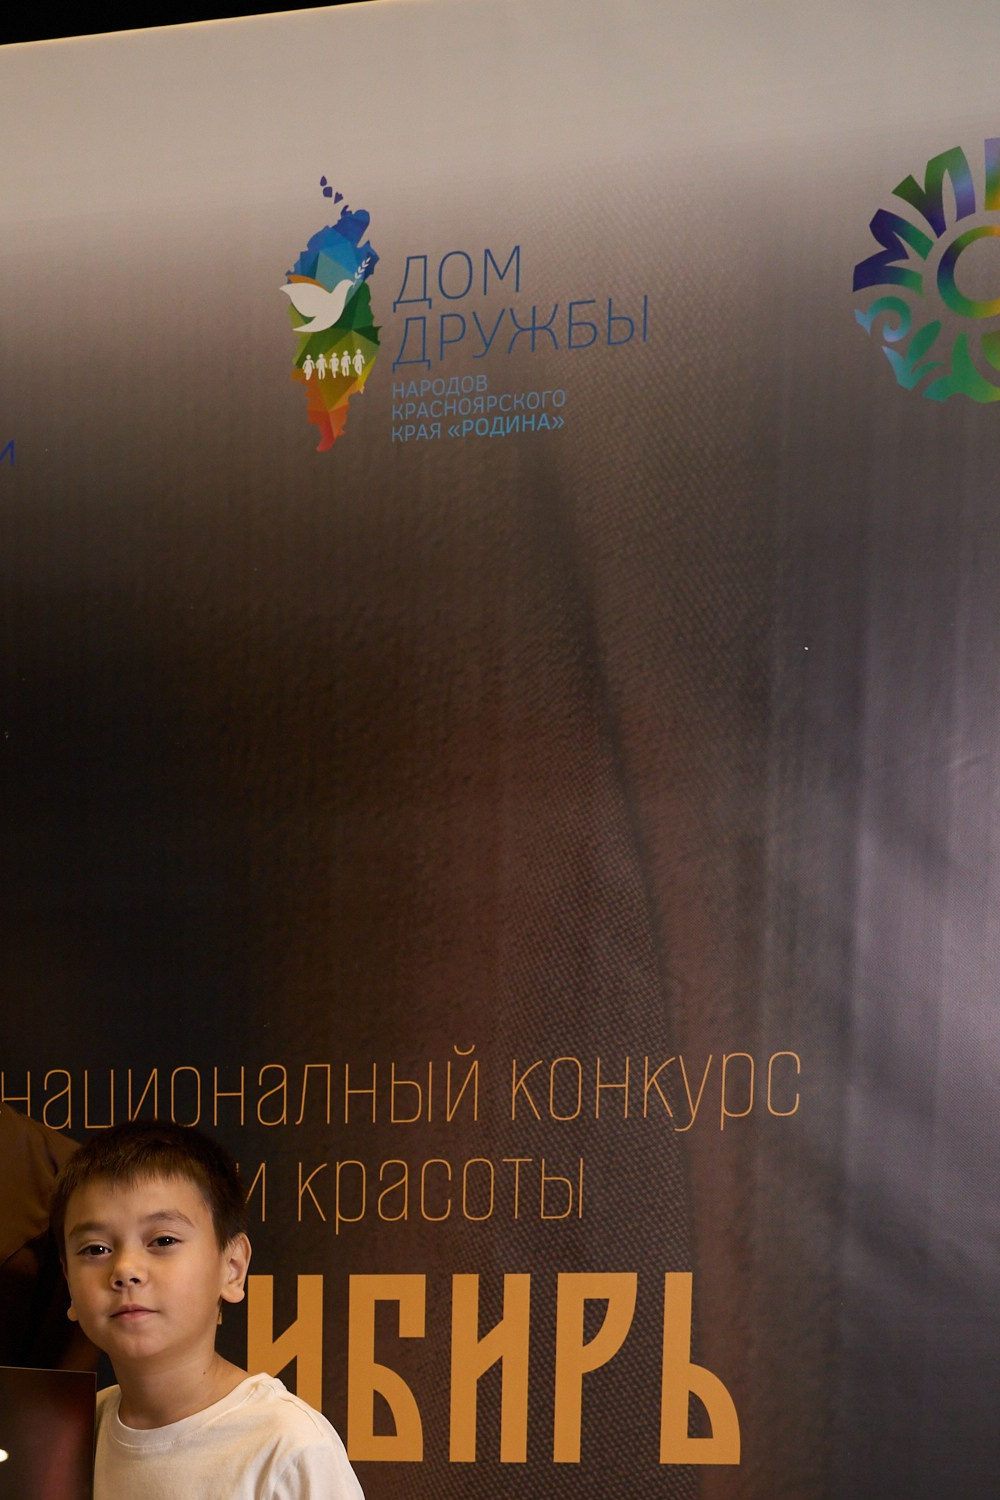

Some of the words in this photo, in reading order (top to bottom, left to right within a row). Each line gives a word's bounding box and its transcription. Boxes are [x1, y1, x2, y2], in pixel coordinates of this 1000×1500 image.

[392, 245, 521, 313] ДОМ
[391, 294, 648, 374] ДРУЖБЫ
[391, 374, 488, 399] НАРОДОВ
[391, 389, 566, 421] КРАСНОЯРСКОГО
[391, 424, 441, 443] КРАЯ
[447, 414, 566, 438] «РОДИНА»
[0, 1043, 480, 1131] националный
[511, 1050, 802, 1132] конкурс
[298, 1157, 584, 1235] красоты
[247, 1271, 742, 1465] ИБИРЬ
